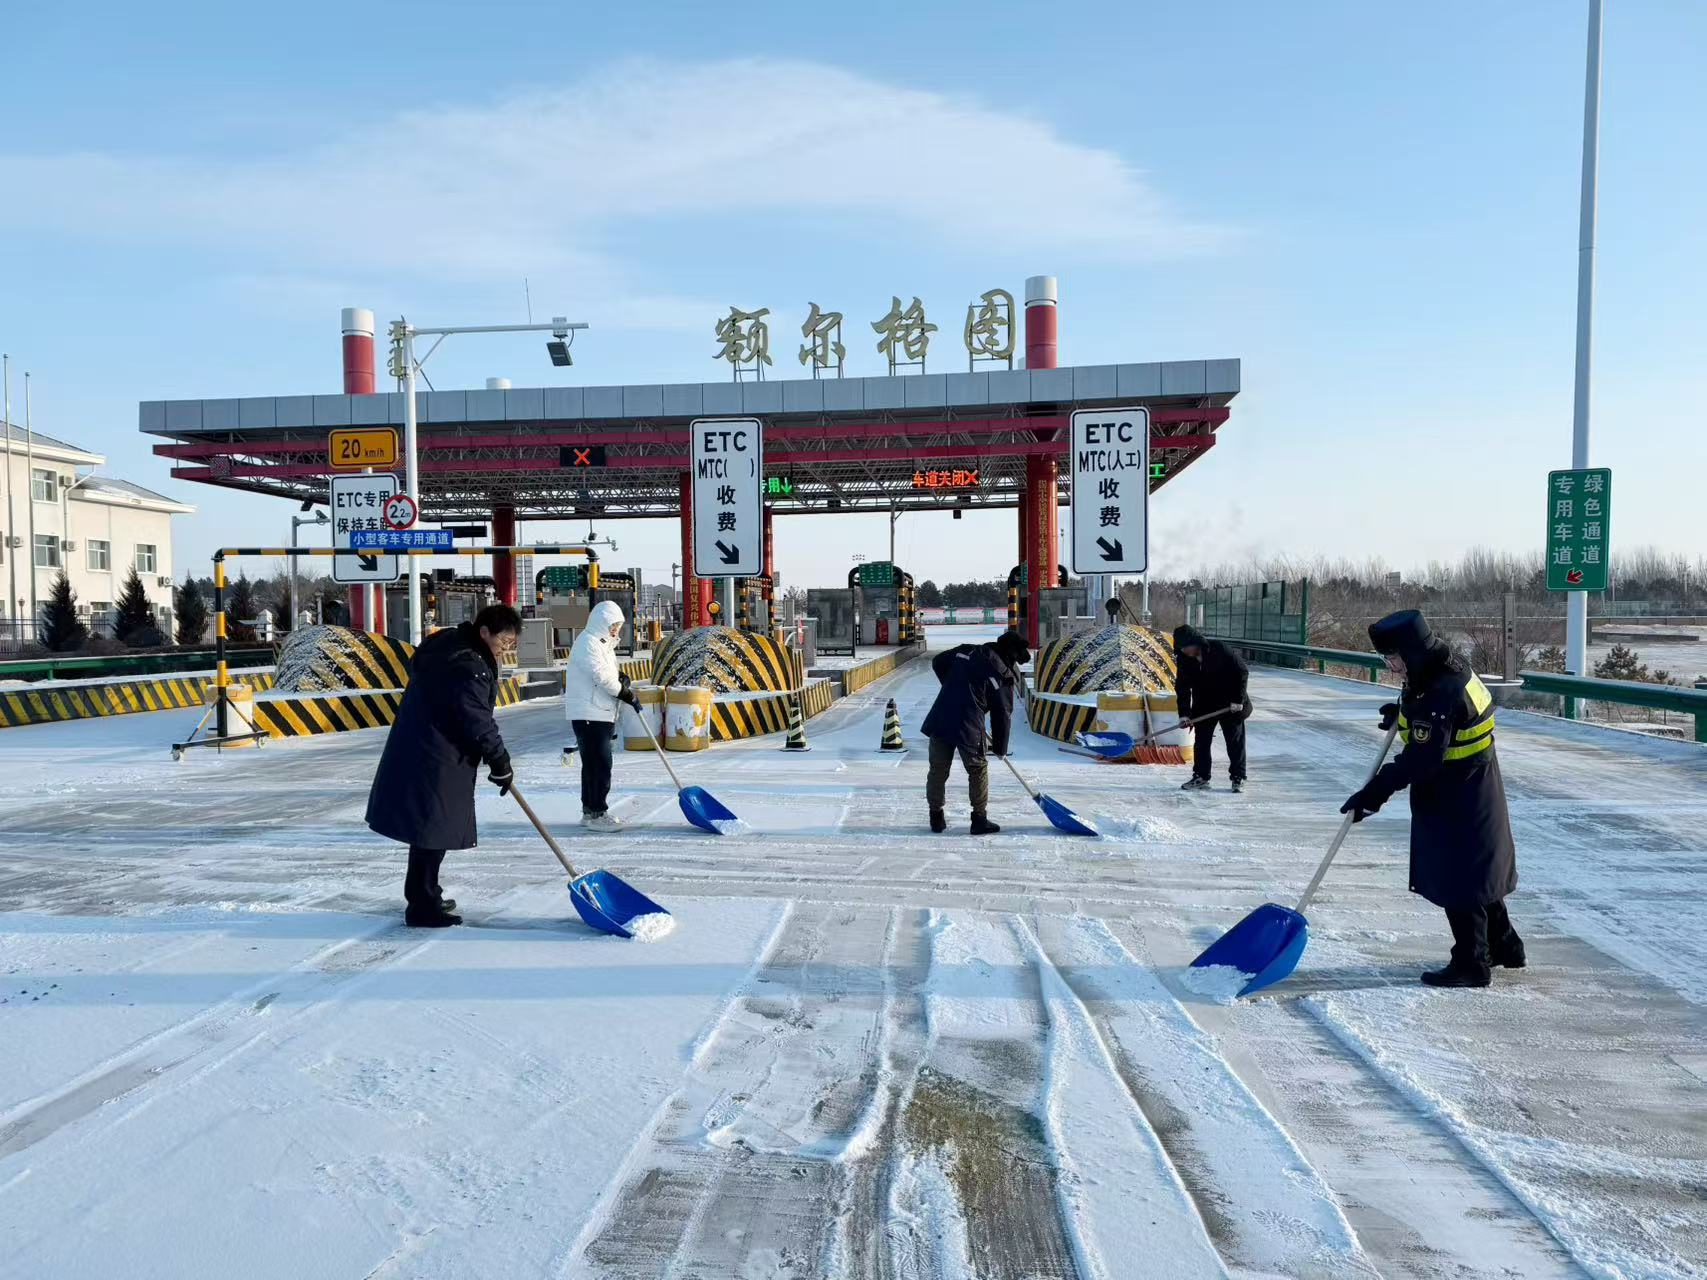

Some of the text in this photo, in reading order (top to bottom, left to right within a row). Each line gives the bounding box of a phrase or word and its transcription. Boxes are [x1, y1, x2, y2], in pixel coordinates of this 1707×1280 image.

[712, 288, 1017, 366] 额尔格图
[704, 431, 747, 453] ETC
[1086, 422, 1133, 444] ETC
[341, 439, 385, 459] 20 km/h
[1079, 450, 1141, 472] MTC(人工)
[912, 470, 965, 487] 车道关闭
[336, 491, 391, 508] ETC专用
[716, 485, 737, 531] 收费
[1099, 478, 1121, 527] 收费
[1552, 476, 1575, 565] 专用车道
[1581, 474, 1604, 565] 绿色通道
[353, 532, 450, 546] 小型客车专用通道
